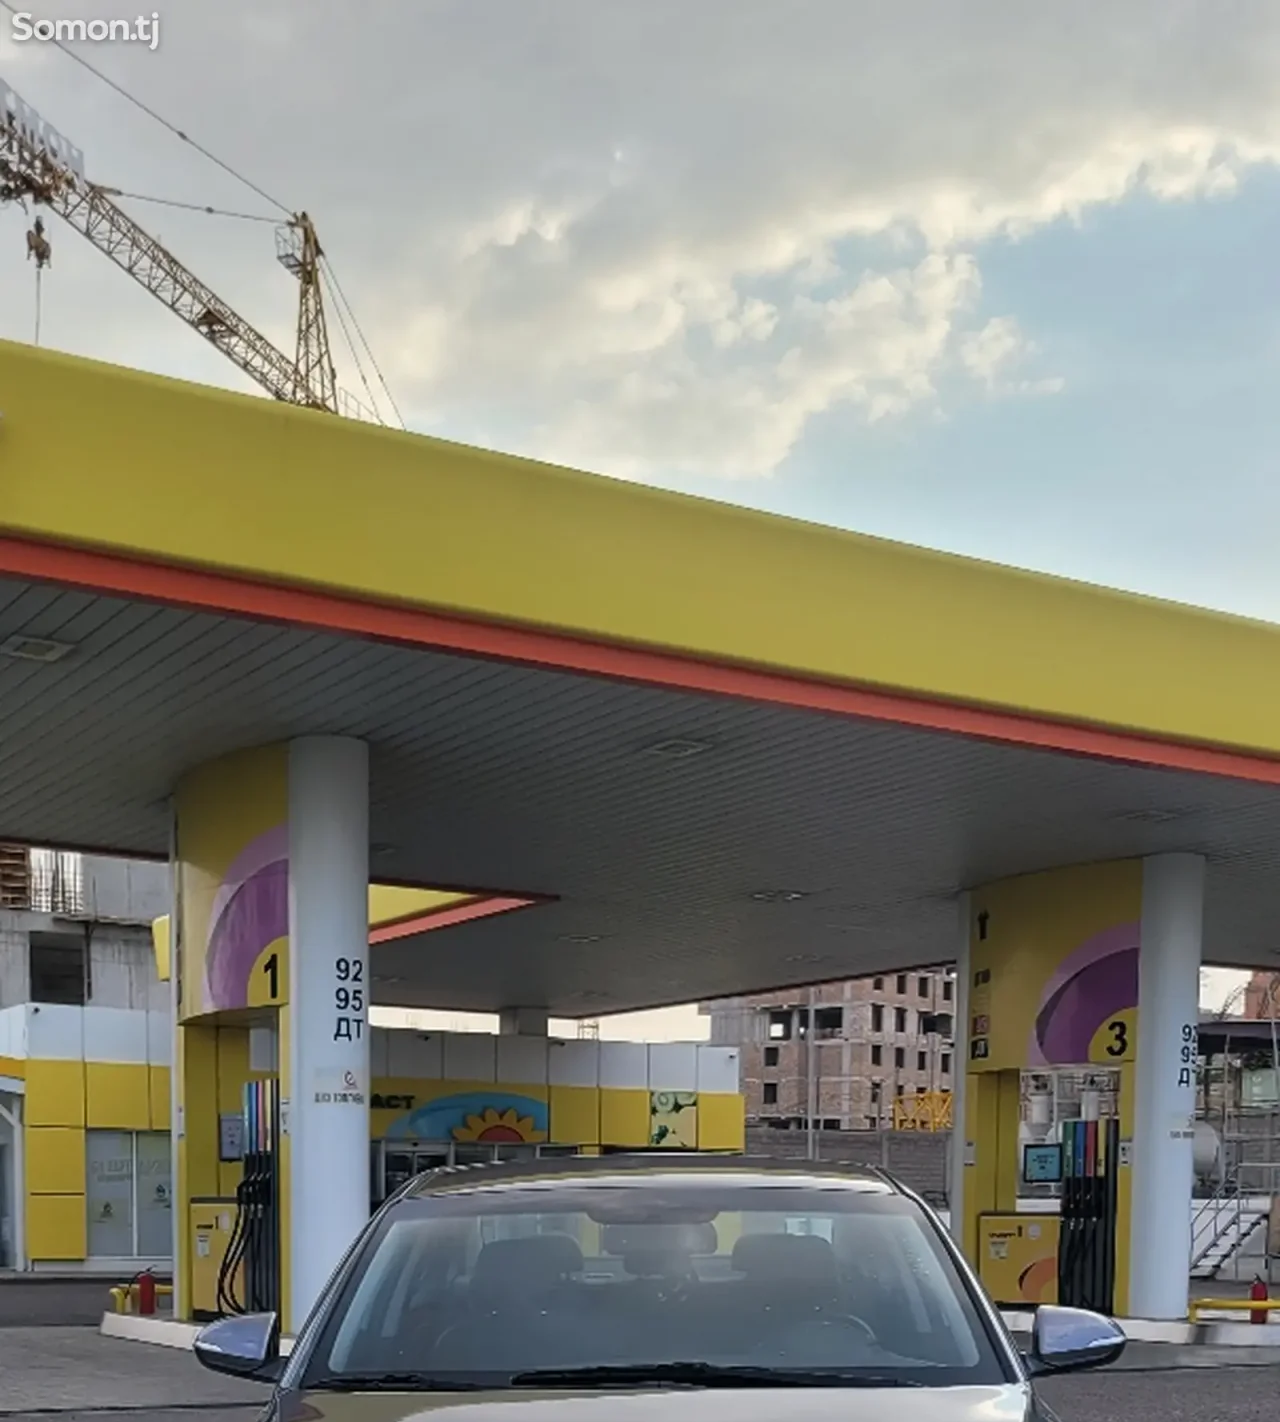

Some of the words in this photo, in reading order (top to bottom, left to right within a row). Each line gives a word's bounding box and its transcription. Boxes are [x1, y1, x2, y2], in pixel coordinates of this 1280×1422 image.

[263, 953, 278, 999] 1
[336, 957, 363, 983] 92
[335, 987, 363, 1012] 95
[333, 1017, 364, 1041] ДТ
[1106, 1021, 1128, 1056] 3
